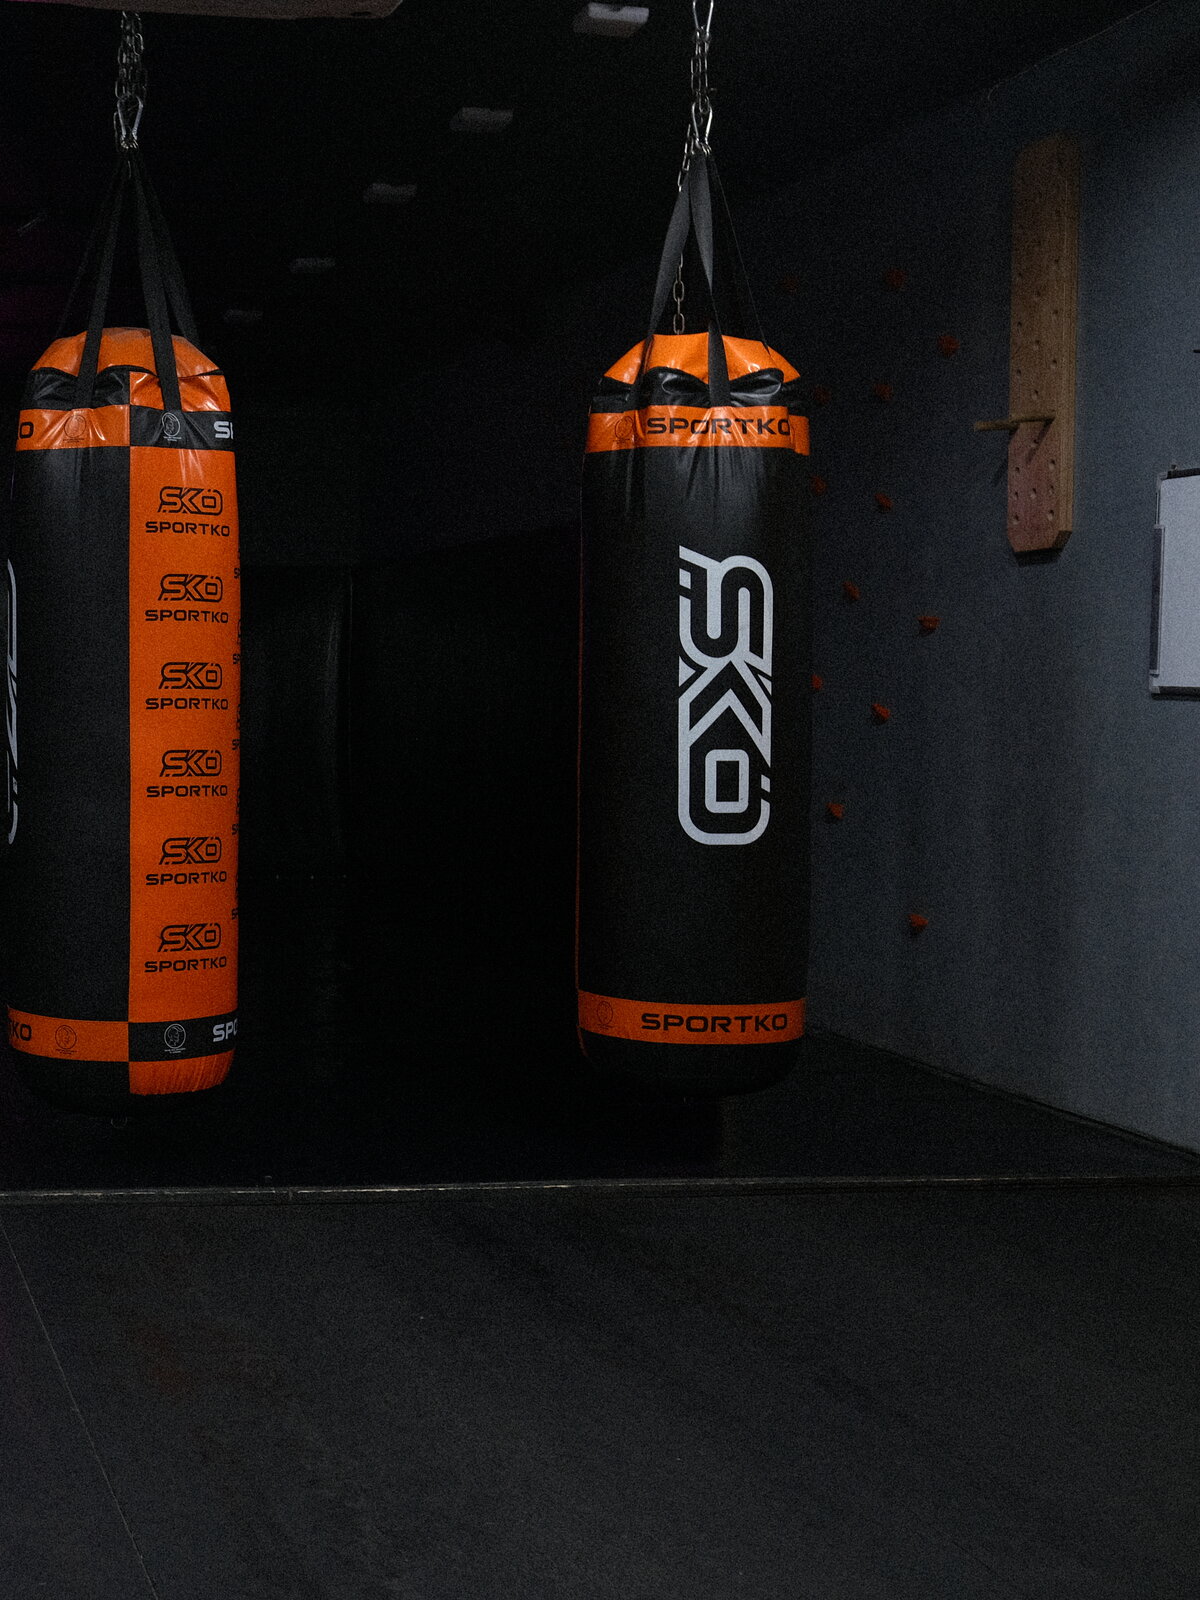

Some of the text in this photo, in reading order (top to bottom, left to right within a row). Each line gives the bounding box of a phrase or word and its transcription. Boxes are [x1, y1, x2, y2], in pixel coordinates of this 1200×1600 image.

[646, 417, 792, 436] SPORTKO
[157, 486, 223, 516] SKO
[145, 521, 230, 537] SPORTKO
[158, 573, 223, 603] SKO
[145, 609, 229, 624] SPORTKO
[158, 661, 223, 690] SKO
[145, 697, 229, 710] SPORTKO
[678, 545, 773, 845] SKO
[160, 749, 222, 777] SKO
[146, 785, 228, 798] SPORTKO
[159, 836, 222, 865] SKO
[145, 871, 227, 886] SPORTKO
[157, 922, 222, 953] SKO
[144, 956, 227, 973] SPORTKO
[641, 1012, 788, 1033] SPORTKO
